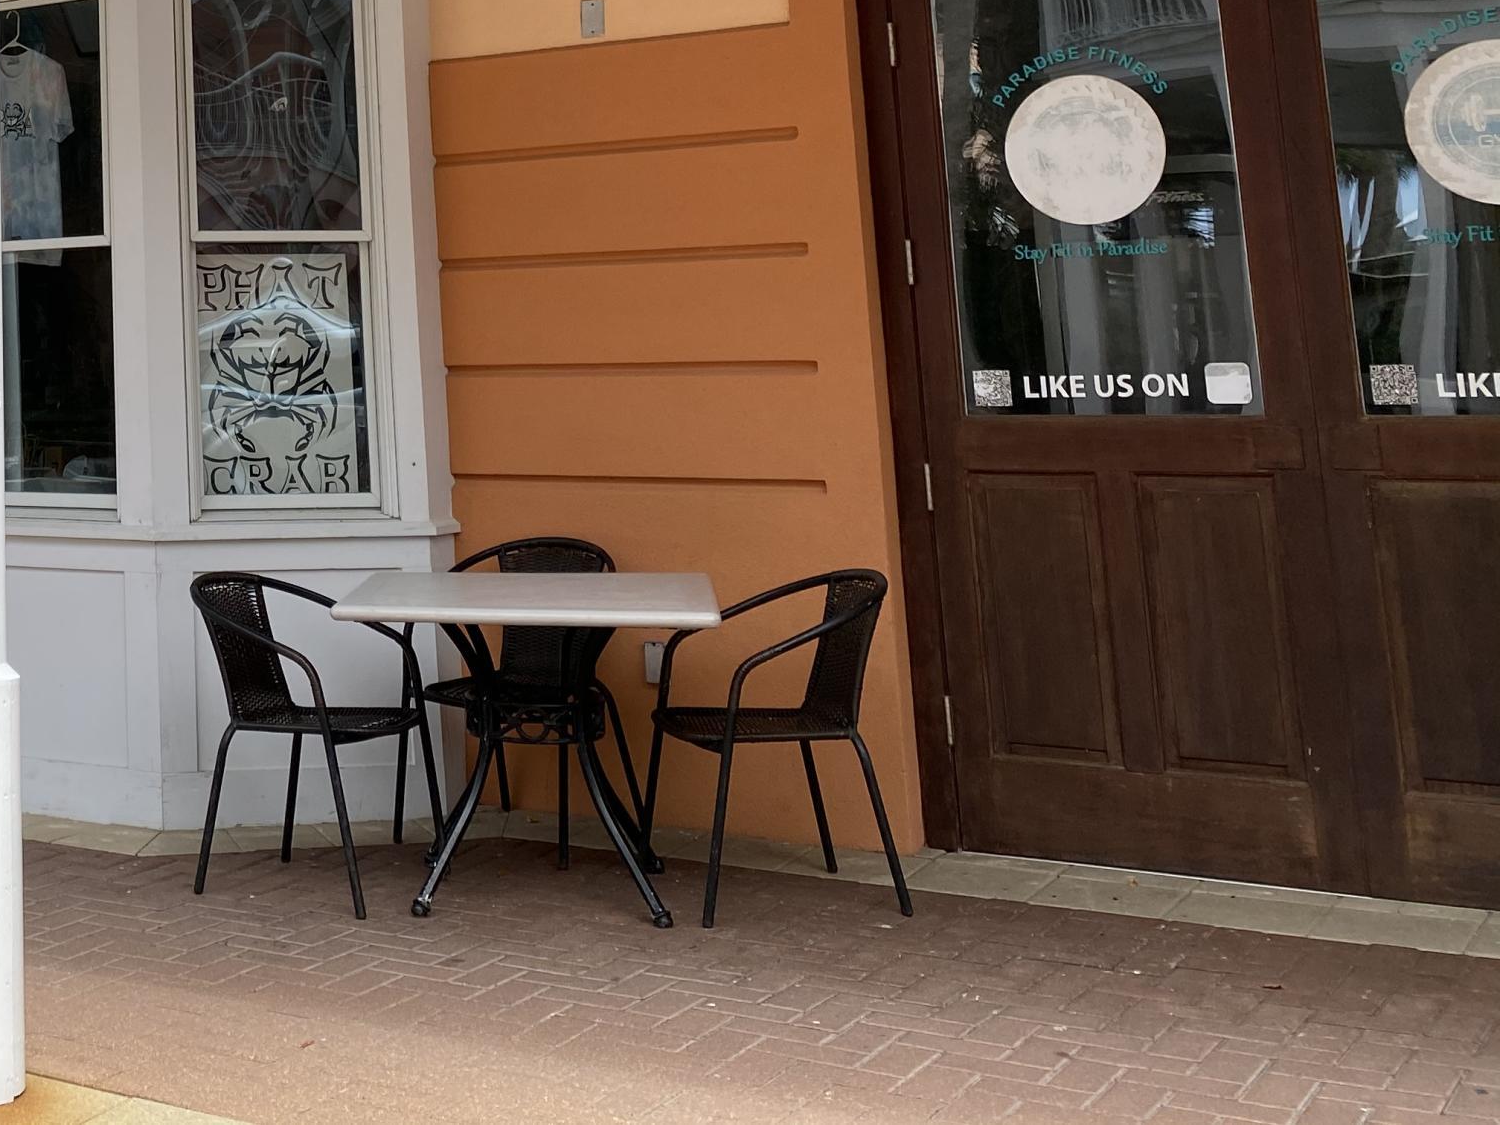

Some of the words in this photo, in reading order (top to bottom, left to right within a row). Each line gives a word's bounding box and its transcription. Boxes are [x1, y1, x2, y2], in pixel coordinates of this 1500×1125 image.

[1390, 6, 1499, 76] PARADISE
[991, 46, 1080, 108] PARADISE
[1088, 46, 1168, 95] FITNESS
[1014, 244, 1048, 265] Stay
[1098, 237, 1168, 257] Paradise
[1467, 225, 1495, 243] Fit
[197, 263, 343, 312] PHAT
[1023, 375, 1086, 399] LIKE
[1094, 374, 1134, 398] US
[1141, 373, 1190, 398] ON
[203, 453, 350, 495] CRAB
